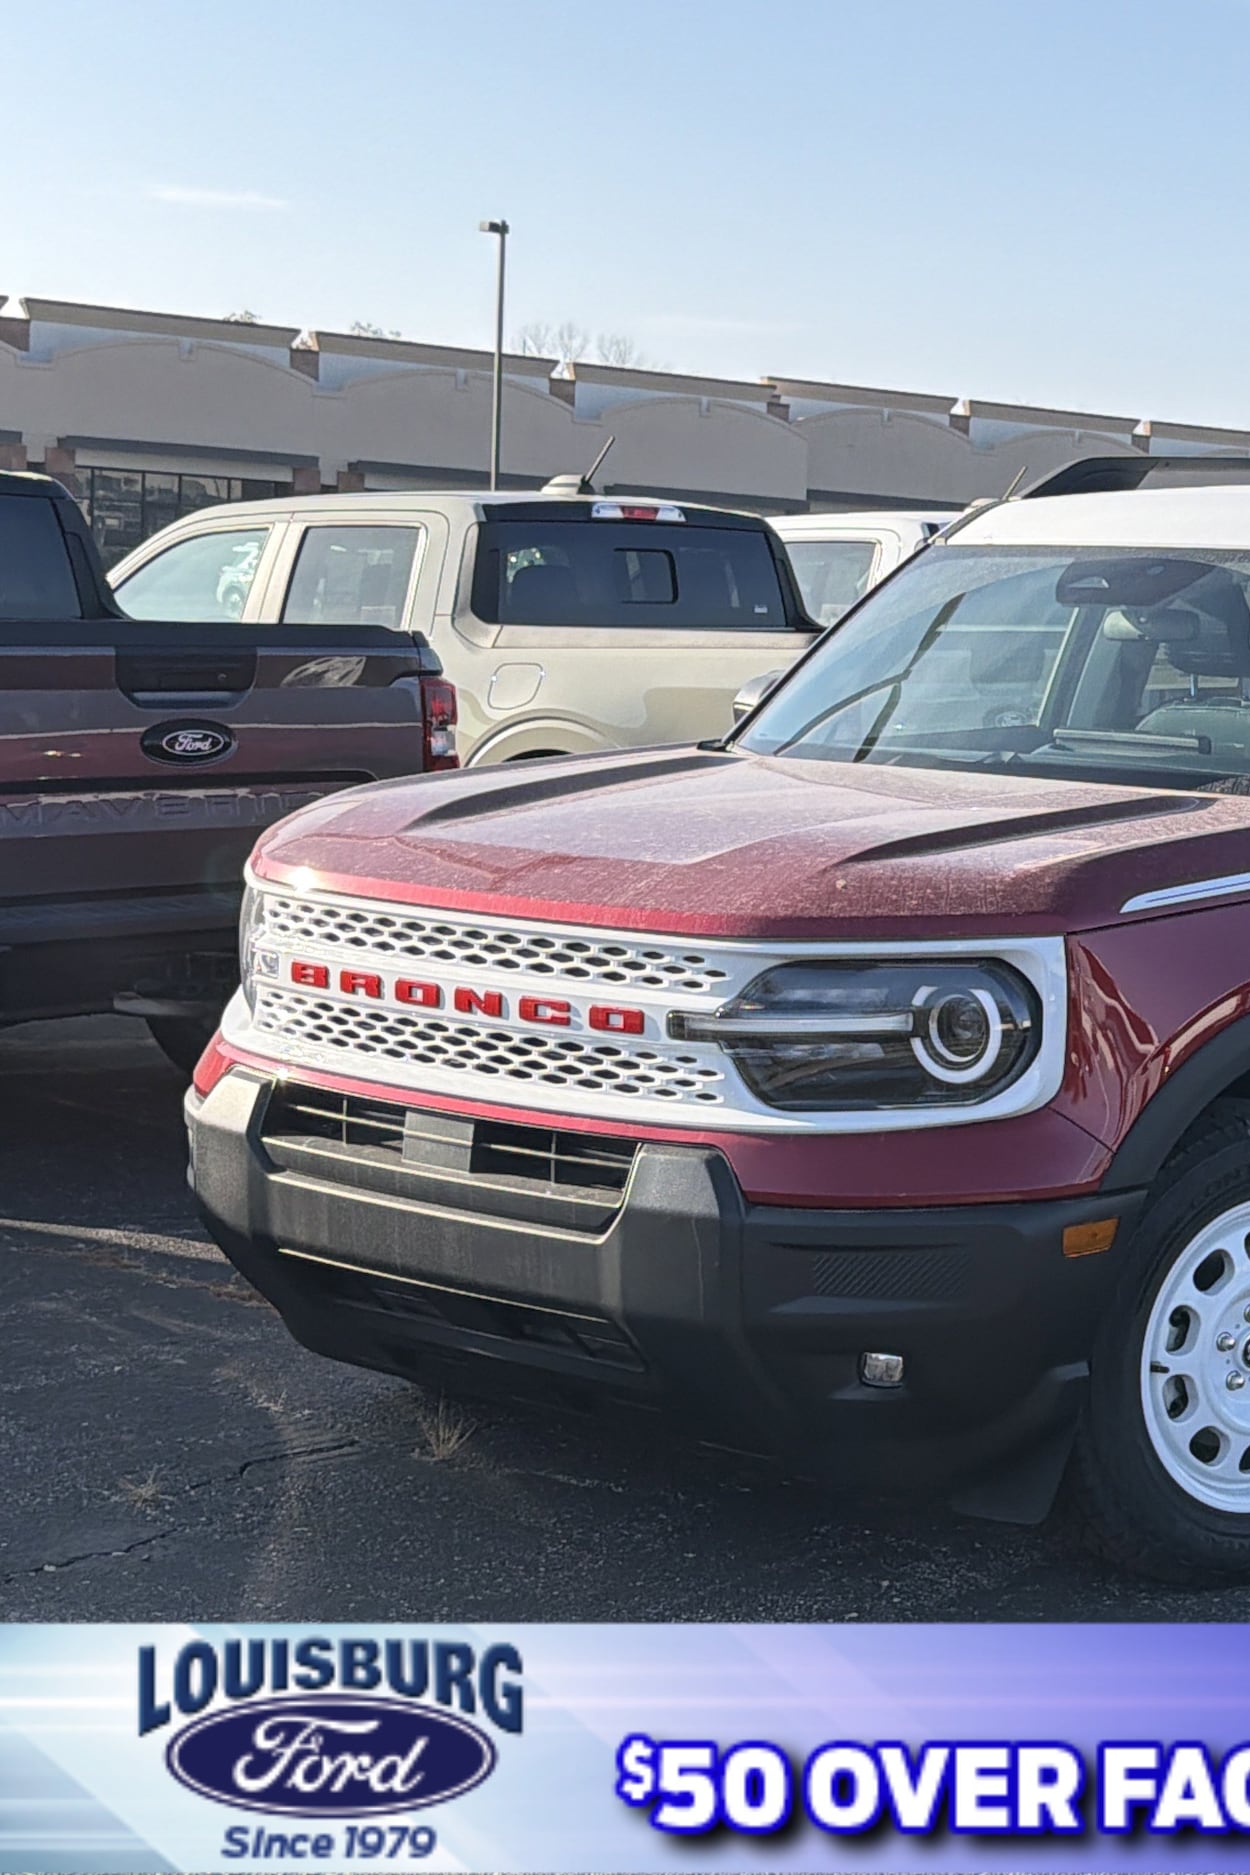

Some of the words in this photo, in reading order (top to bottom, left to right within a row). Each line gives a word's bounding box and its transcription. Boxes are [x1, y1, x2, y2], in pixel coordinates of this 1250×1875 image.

[175, 733, 212, 751] Ford
[1, 790, 312, 828] MAVERIC
[291, 960, 645, 1035] BRONCO
